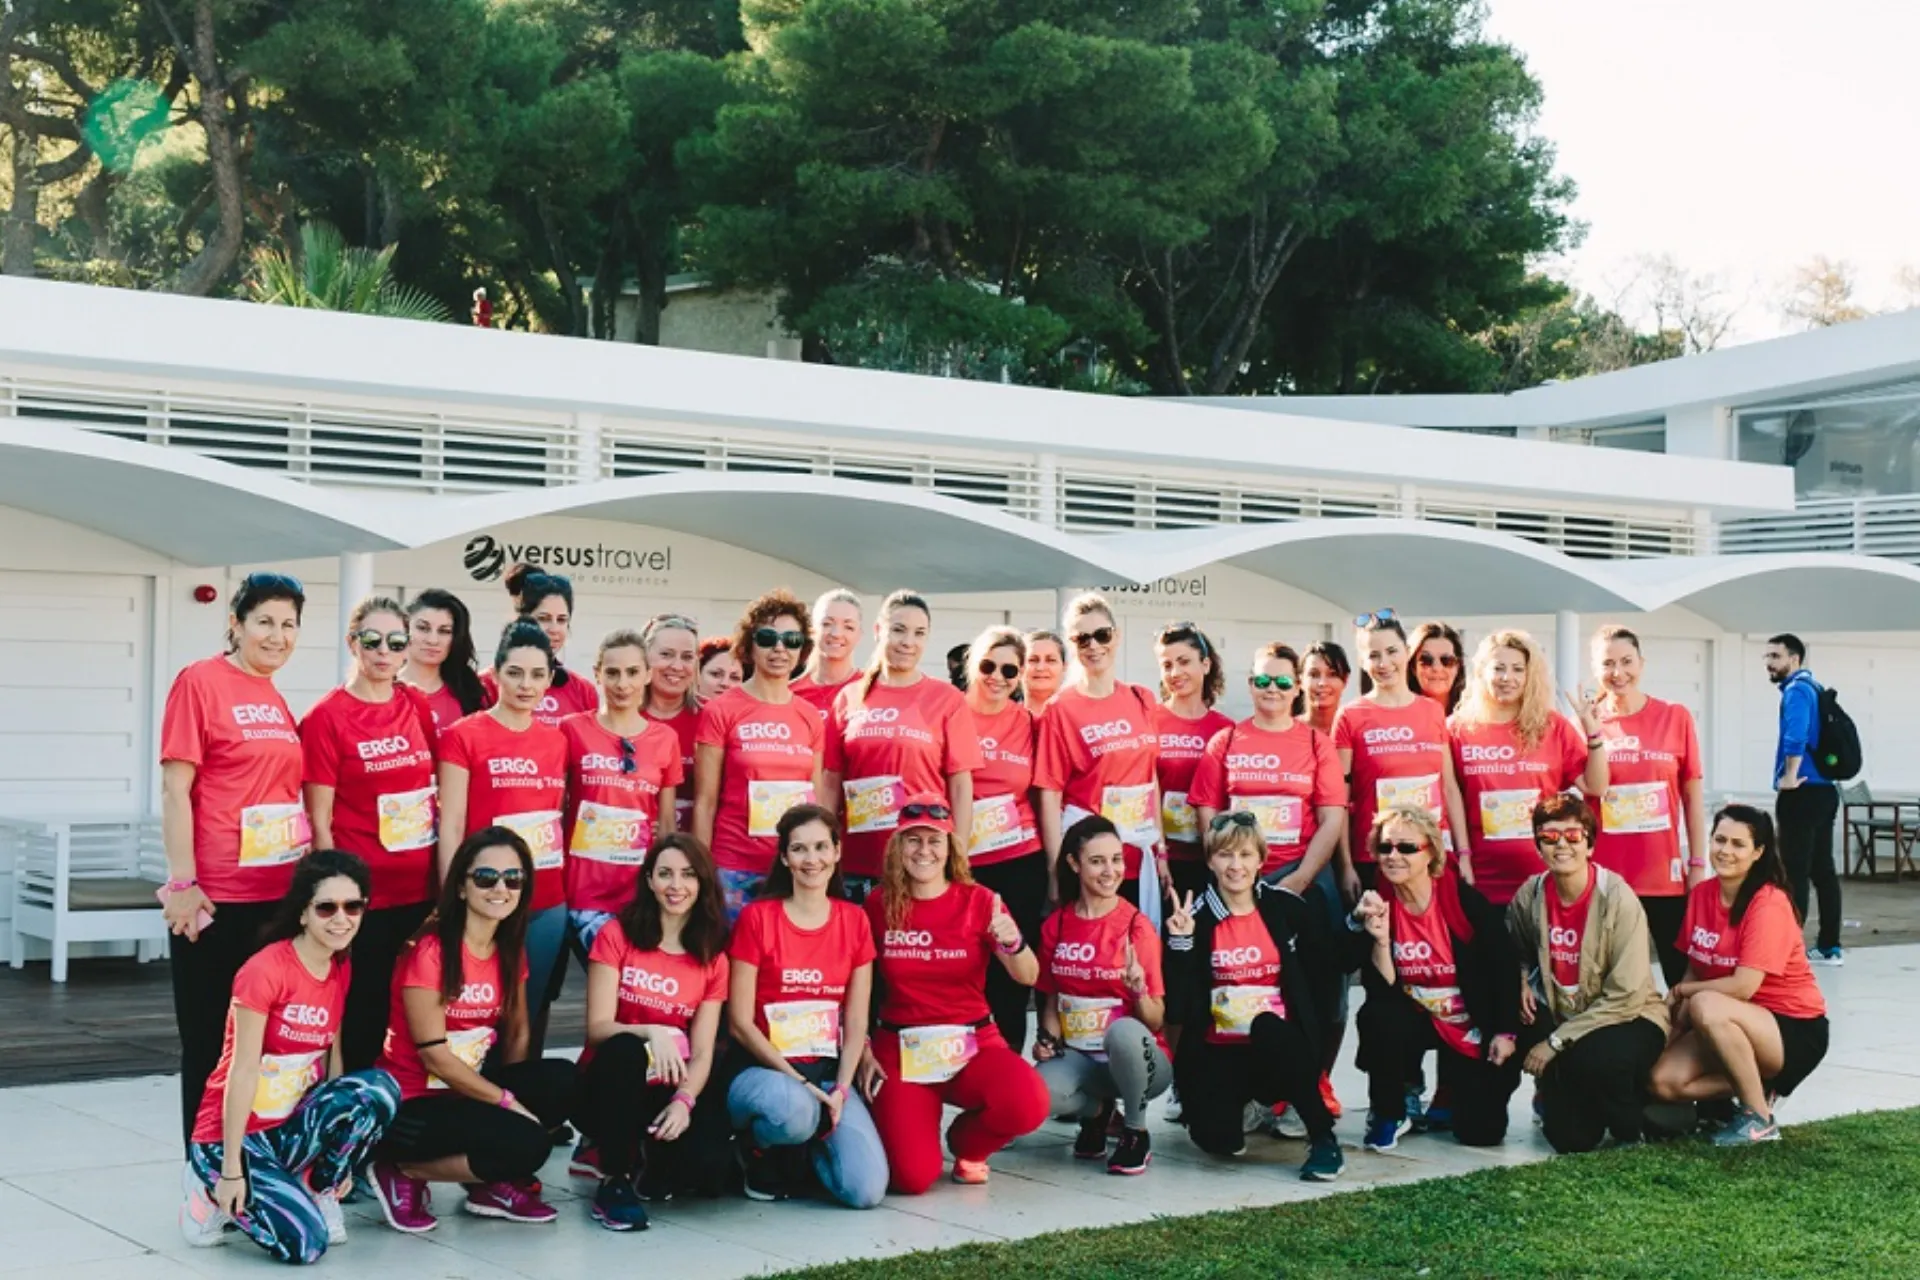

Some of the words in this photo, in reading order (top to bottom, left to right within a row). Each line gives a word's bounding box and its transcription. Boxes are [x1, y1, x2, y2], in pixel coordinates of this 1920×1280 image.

[507, 543, 671, 571] versustravel
[232, 704, 286, 724] ERGO
[738, 722, 791, 740] ERGO
[1080, 719, 1132, 744] ERGO
[1363, 727, 1414, 743] ERGO
[357, 735, 410, 759] ERGO
[1160, 734, 1205, 749] ERGO
[581, 753, 625, 771] ERG
[1225, 754, 1280, 769] ERGO
[1461, 745, 1515, 761] ERGO
[364, 754, 417, 773] Running
[488, 757, 538, 775] ERGO
[883, 930, 932, 946] ERGO
[1550, 926, 1578, 946] GO
[883, 948, 931, 961] Running
[935, 948, 968, 959] Team
[1211, 946, 1262, 967] ERGO
[622, 966, 680, 996] ERGO
[782, 968, 824, 984] ERGO
[458, 983, 494, 1003] RGO
[618, 987, 674, 1014] Running
[283, 1004, 329, 1027] ERGO
